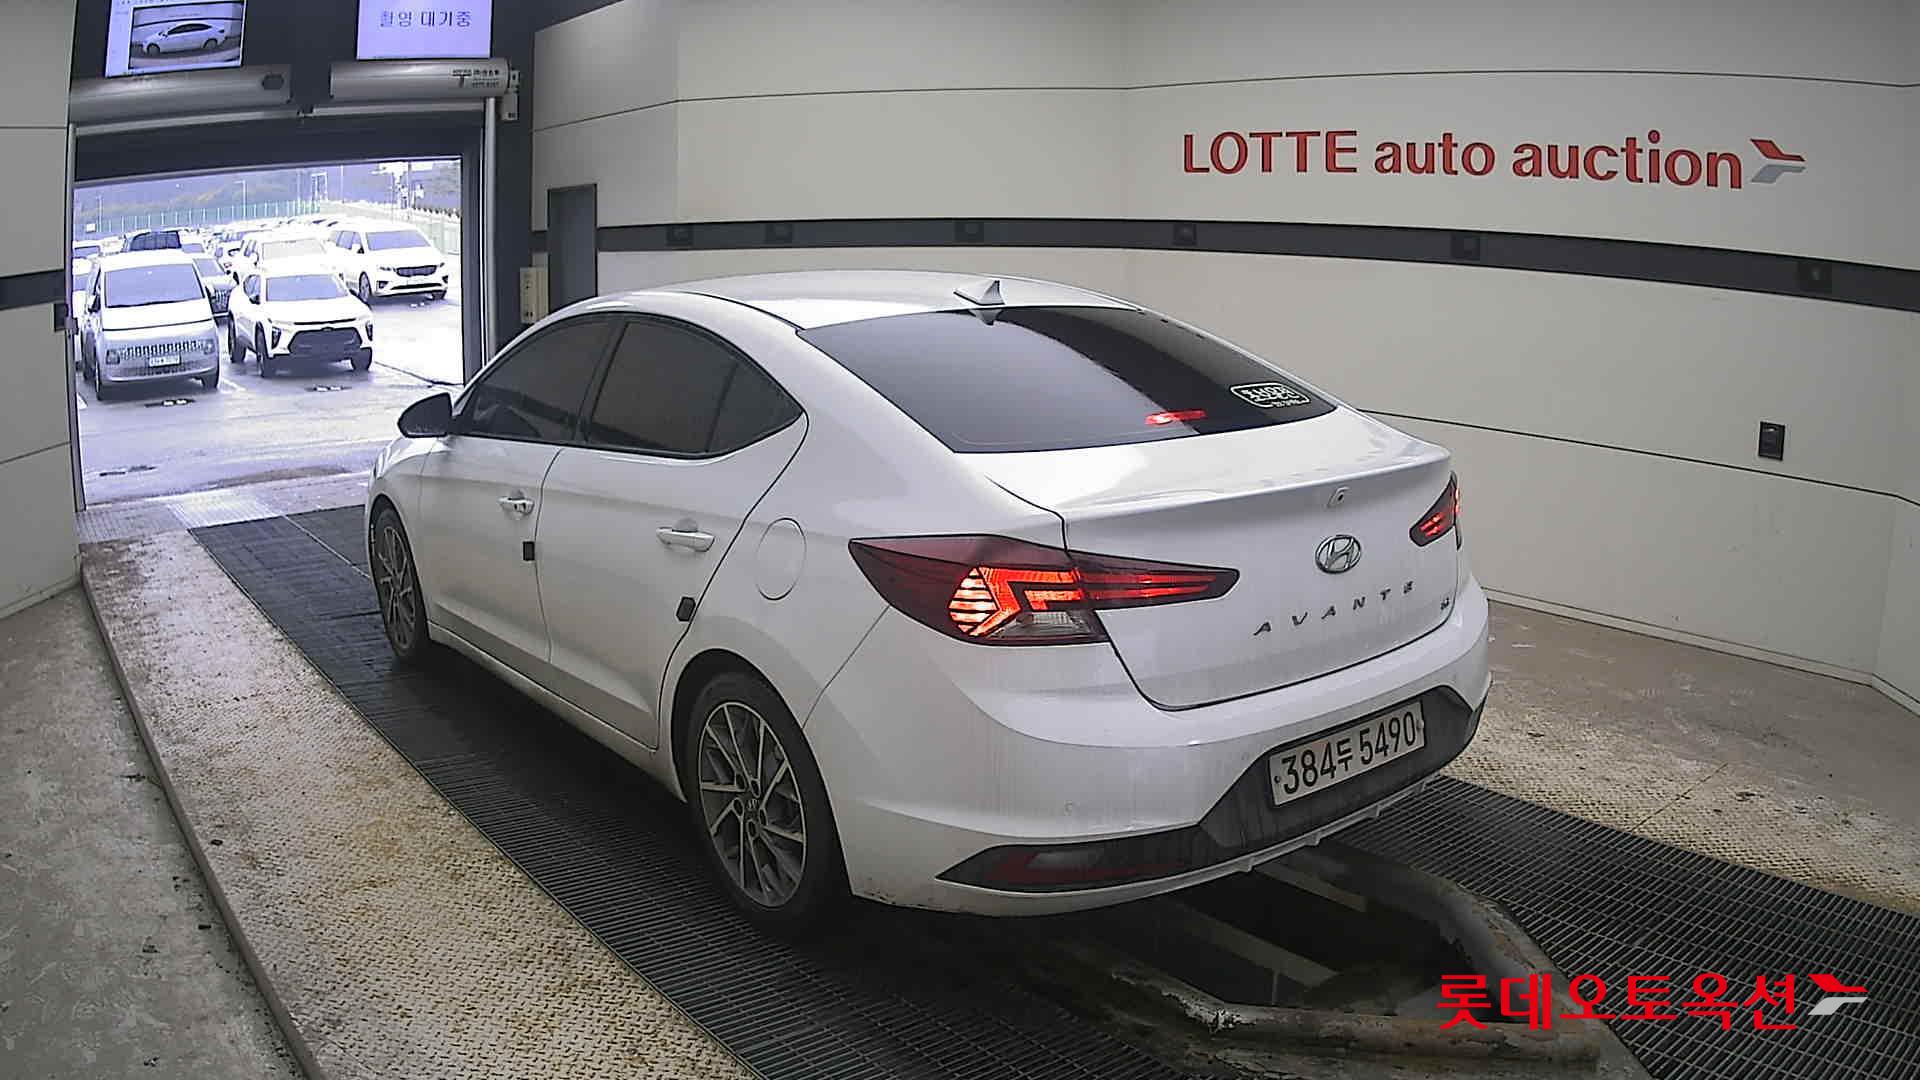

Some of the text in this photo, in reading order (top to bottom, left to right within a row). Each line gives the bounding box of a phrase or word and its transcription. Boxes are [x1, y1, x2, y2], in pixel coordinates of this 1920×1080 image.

[420, 11, 472, 27] 대기중
[1183, 130, 1743, 189] LOTTE auto auction
[1253, 580, 1415, 637] AVANTE
[1281, 711, 1417, 795] 384두 5490
